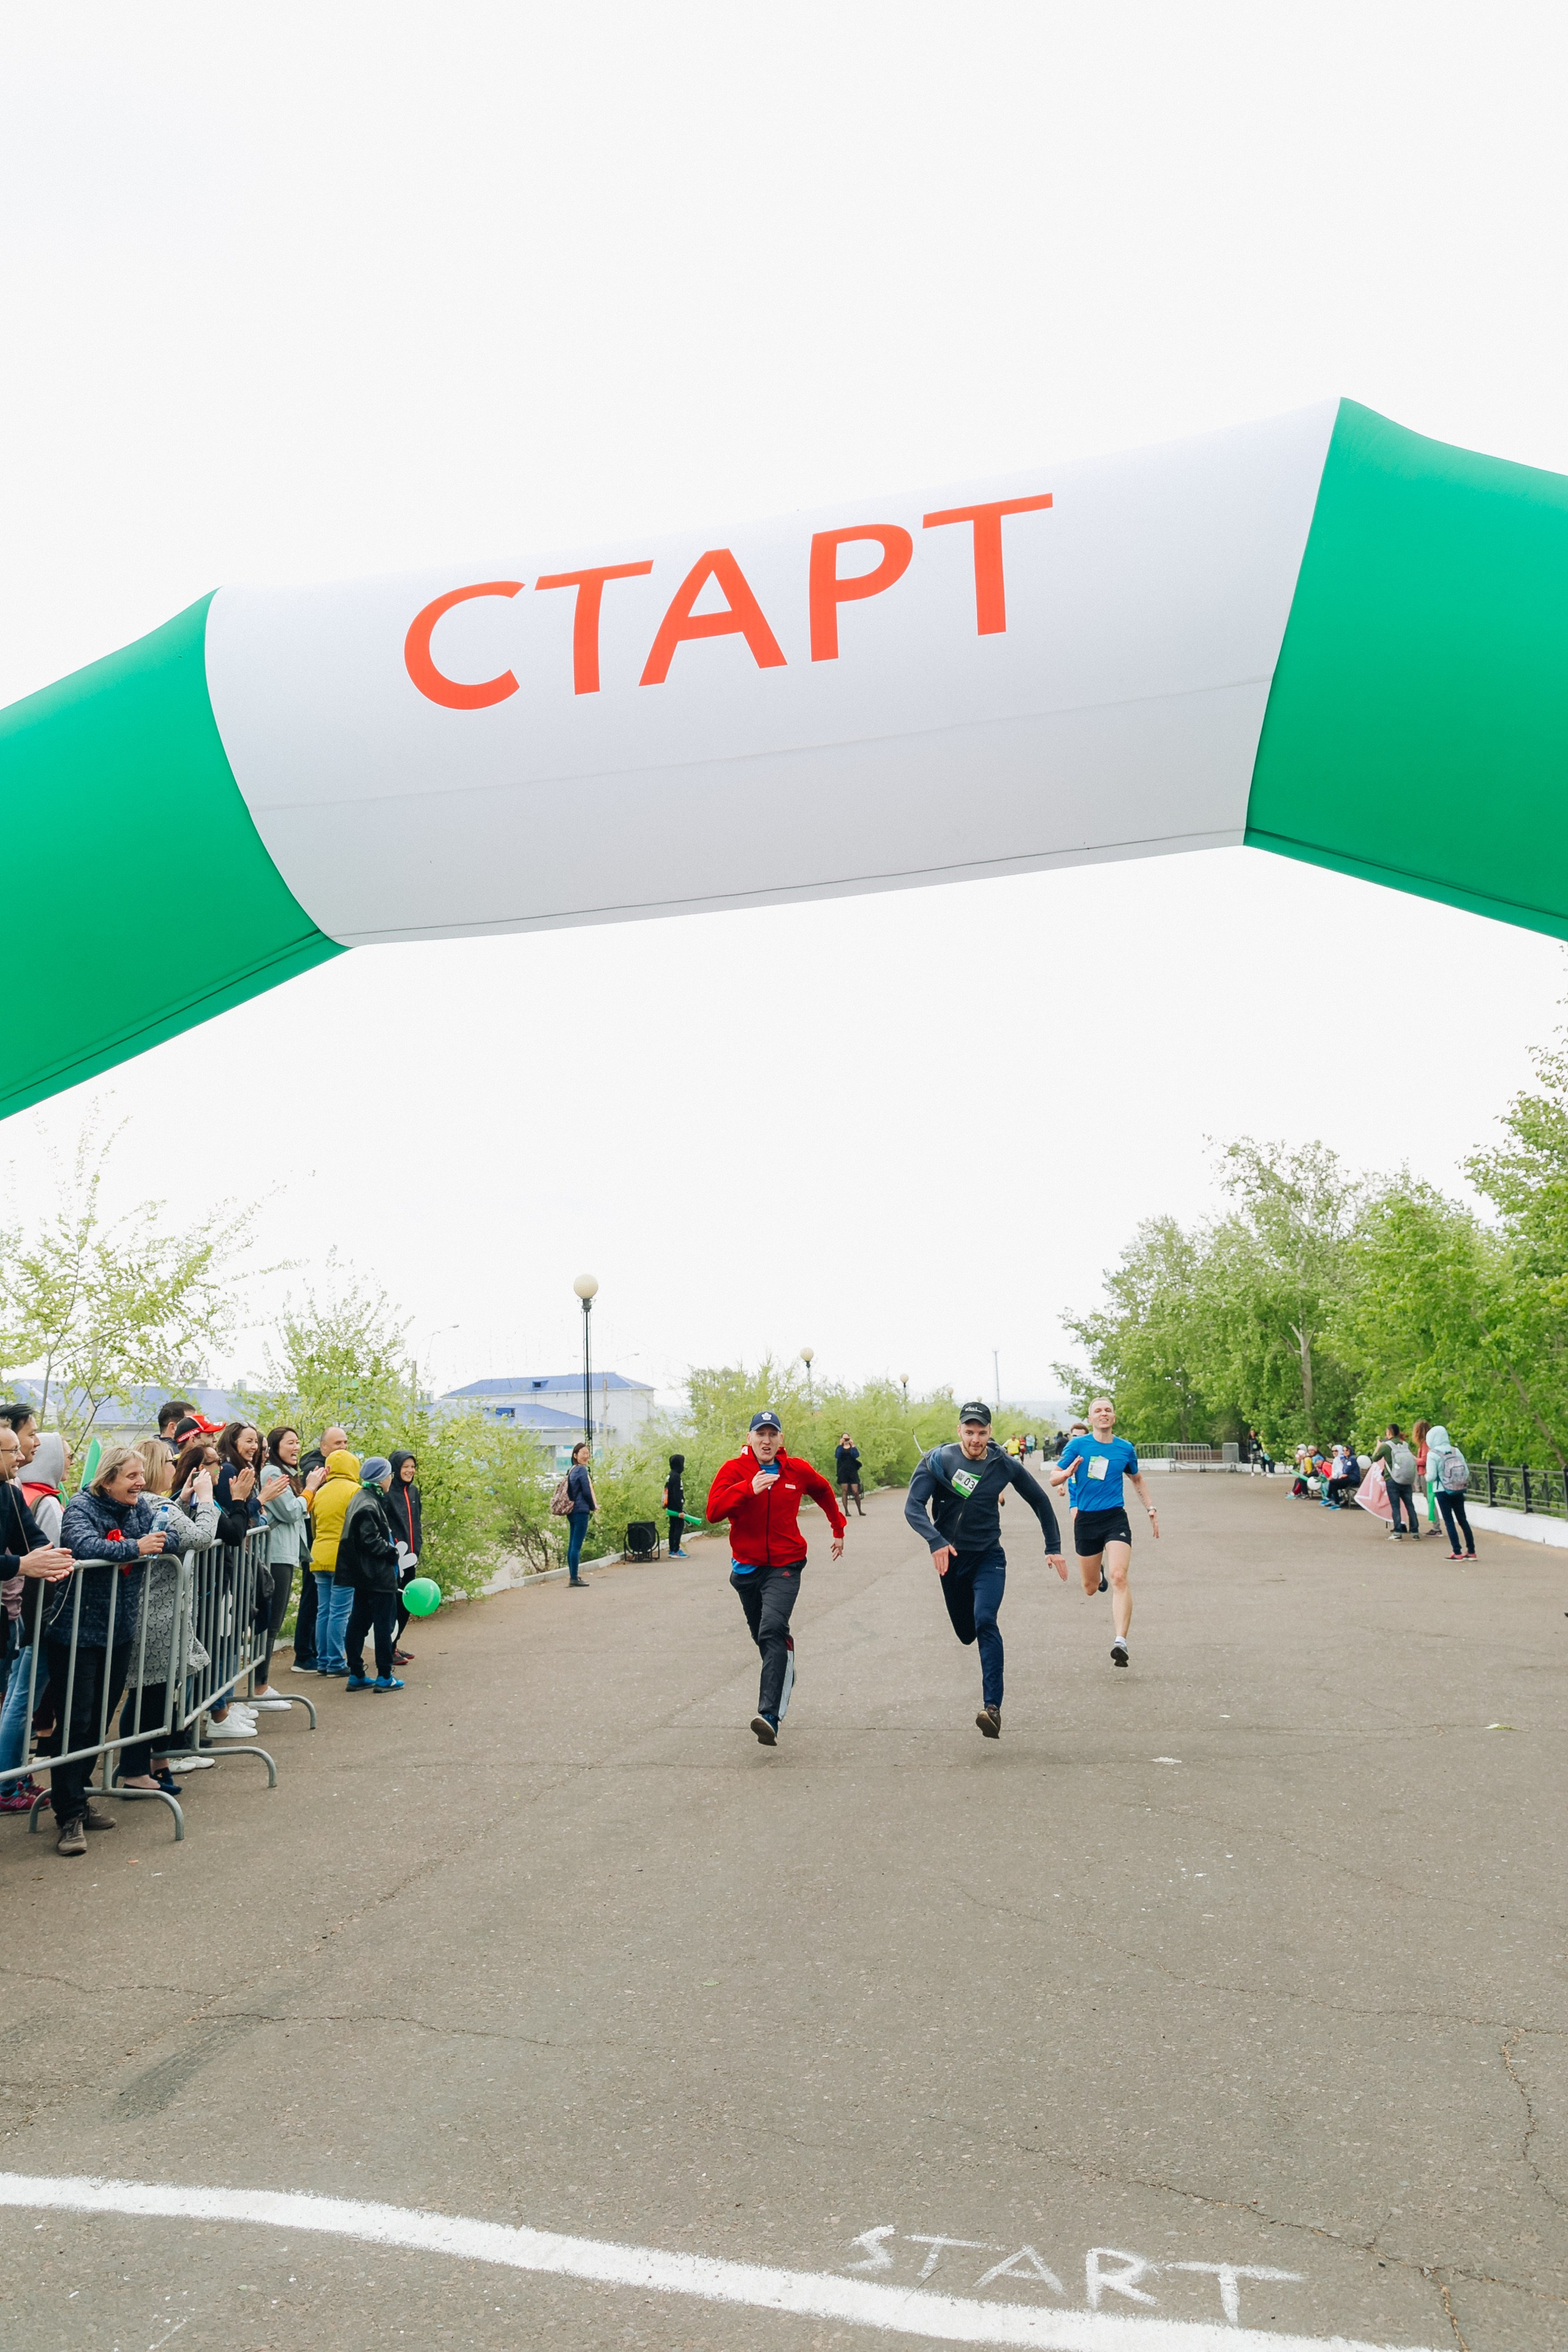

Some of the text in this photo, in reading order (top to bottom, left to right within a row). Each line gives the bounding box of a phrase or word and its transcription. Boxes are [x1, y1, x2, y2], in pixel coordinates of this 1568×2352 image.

[404, 493, 1053, 710] СТАРТ
[178, 1429, 200, 1442] HONDA
[843, 2223, 1310, 2328] START
